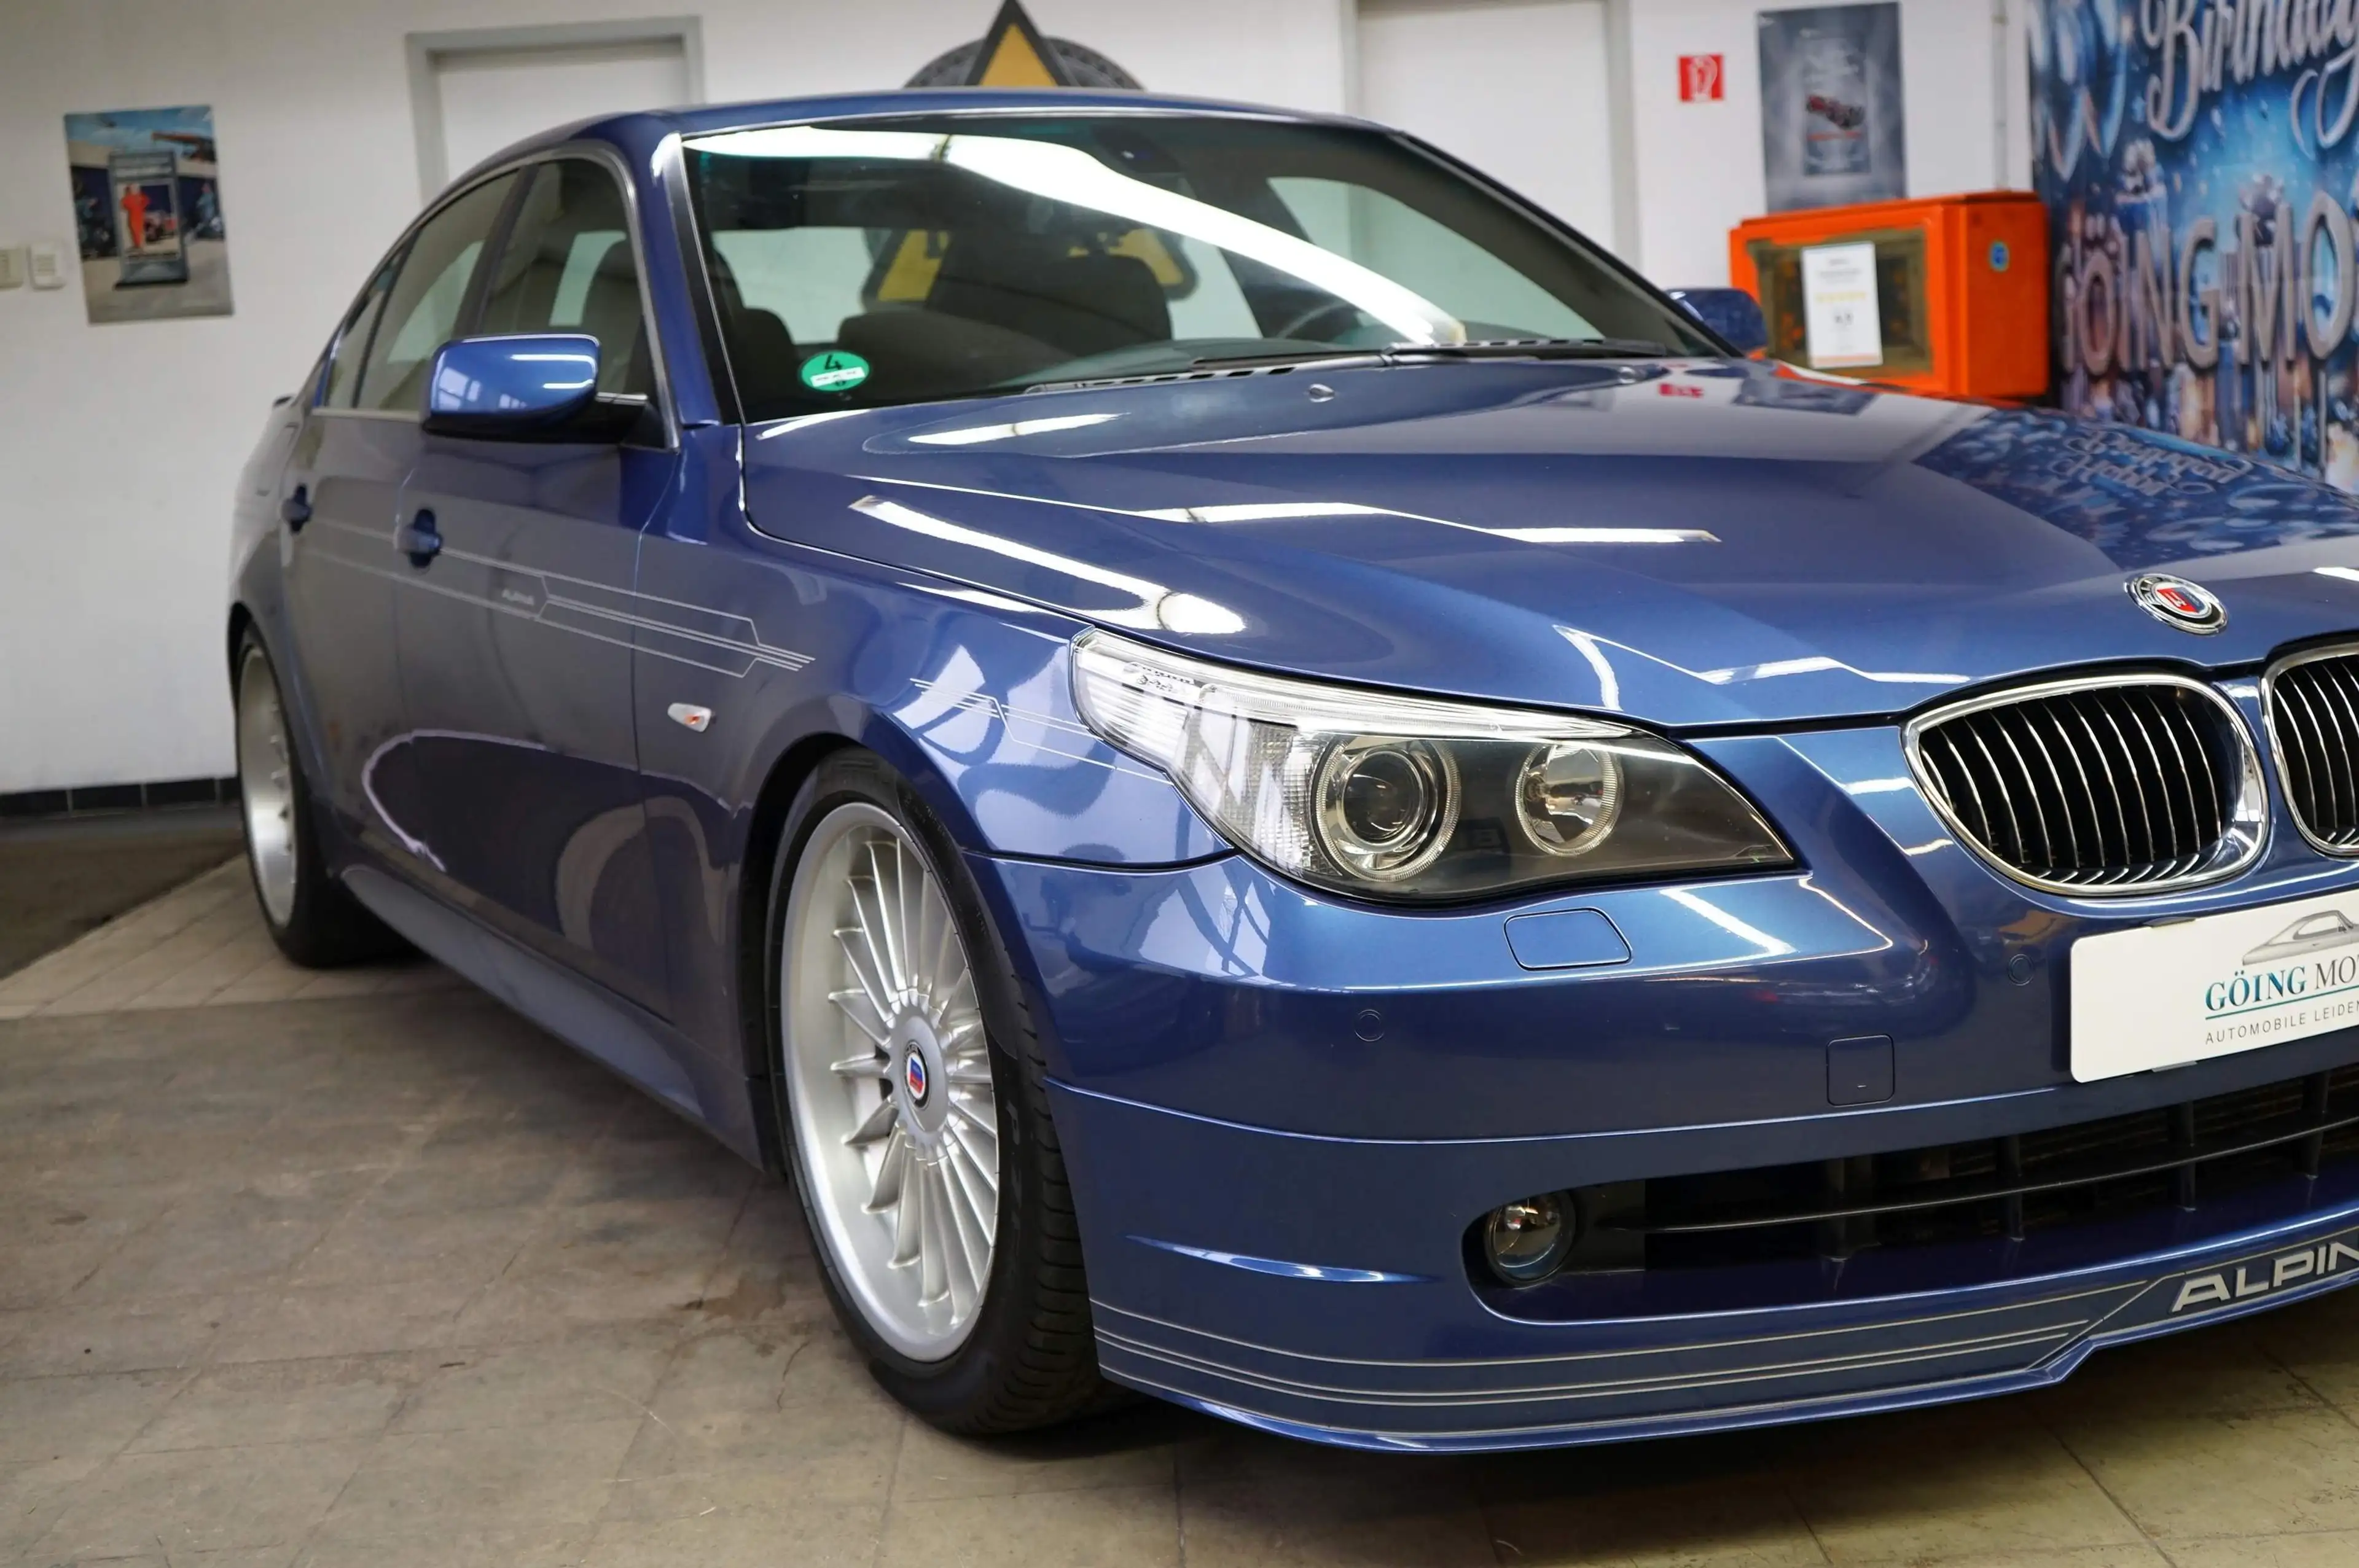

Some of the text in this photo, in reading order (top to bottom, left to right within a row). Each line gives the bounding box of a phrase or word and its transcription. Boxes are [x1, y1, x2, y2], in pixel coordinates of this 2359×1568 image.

[824, 354, 842, 370] 4
[2205, 954, 2359, 1011] GÖING MO
[2205, 1000, 2359, 1045] AUTOMOBILE LEIDE
